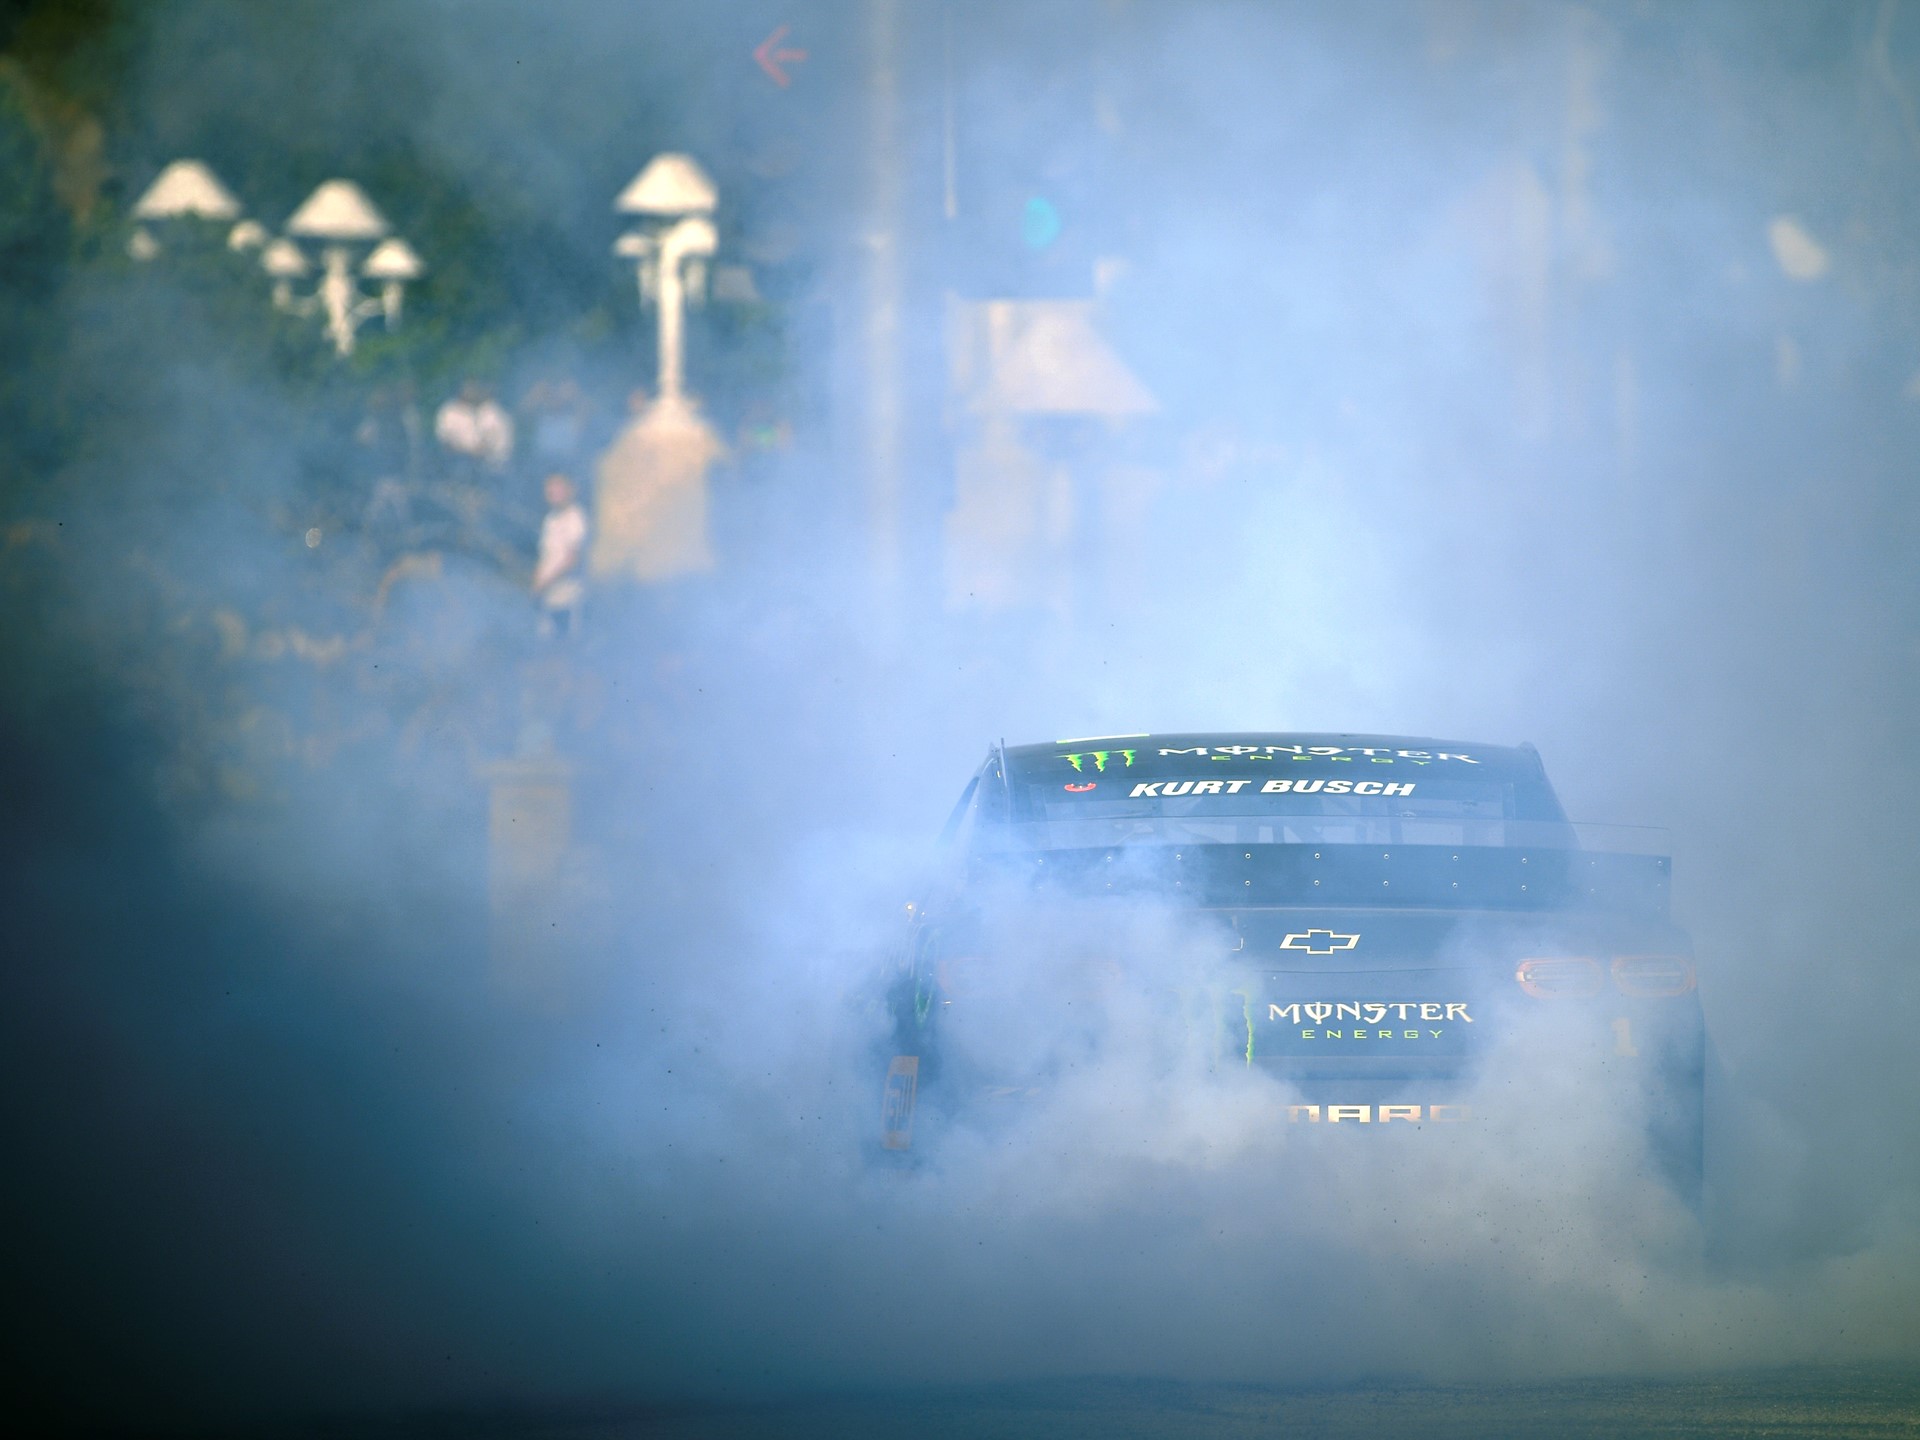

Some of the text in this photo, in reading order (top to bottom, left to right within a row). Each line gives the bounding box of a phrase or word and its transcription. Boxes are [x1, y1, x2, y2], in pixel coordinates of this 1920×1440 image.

[1158, 745, 1480, 764] MONSTER
[1211, 755, 1431, 766] ENERGY
[1129, 780, 1416, 797] KURT BUSCH
[1268, 1001, 1474, 1025] MONSTER
[1301, 1029, 1443, 1040] ENERGY
